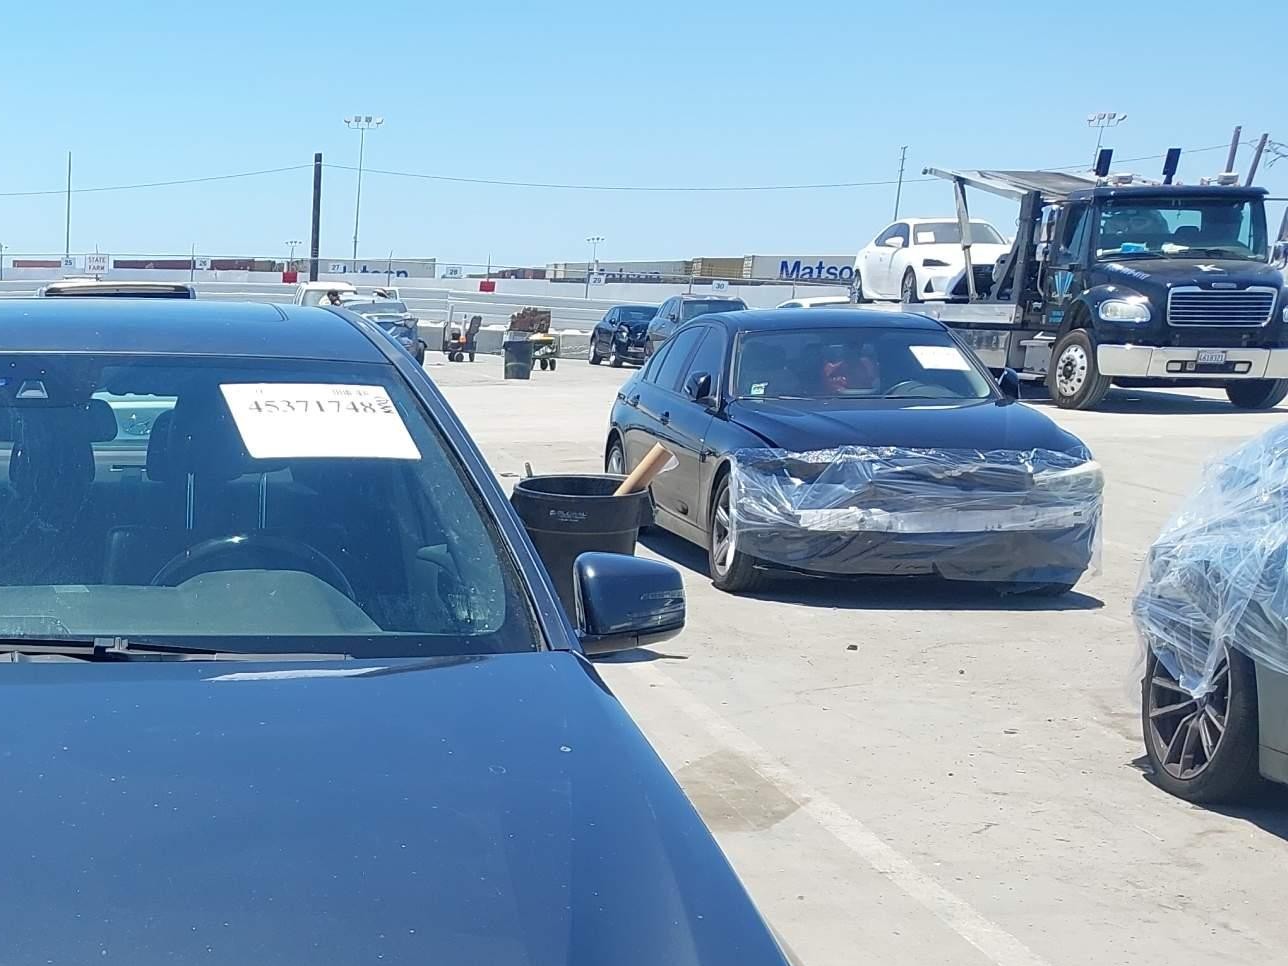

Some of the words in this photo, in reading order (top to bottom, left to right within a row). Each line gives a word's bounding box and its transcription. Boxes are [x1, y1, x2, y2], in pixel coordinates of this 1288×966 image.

[64, 258, 73, 266] 25
[88, 256, 107, 264] STATE
[779, 259, 854, 280] Matso
[716, 282, 725, 290] 30
[249, 399, 377, 414] 45371748
